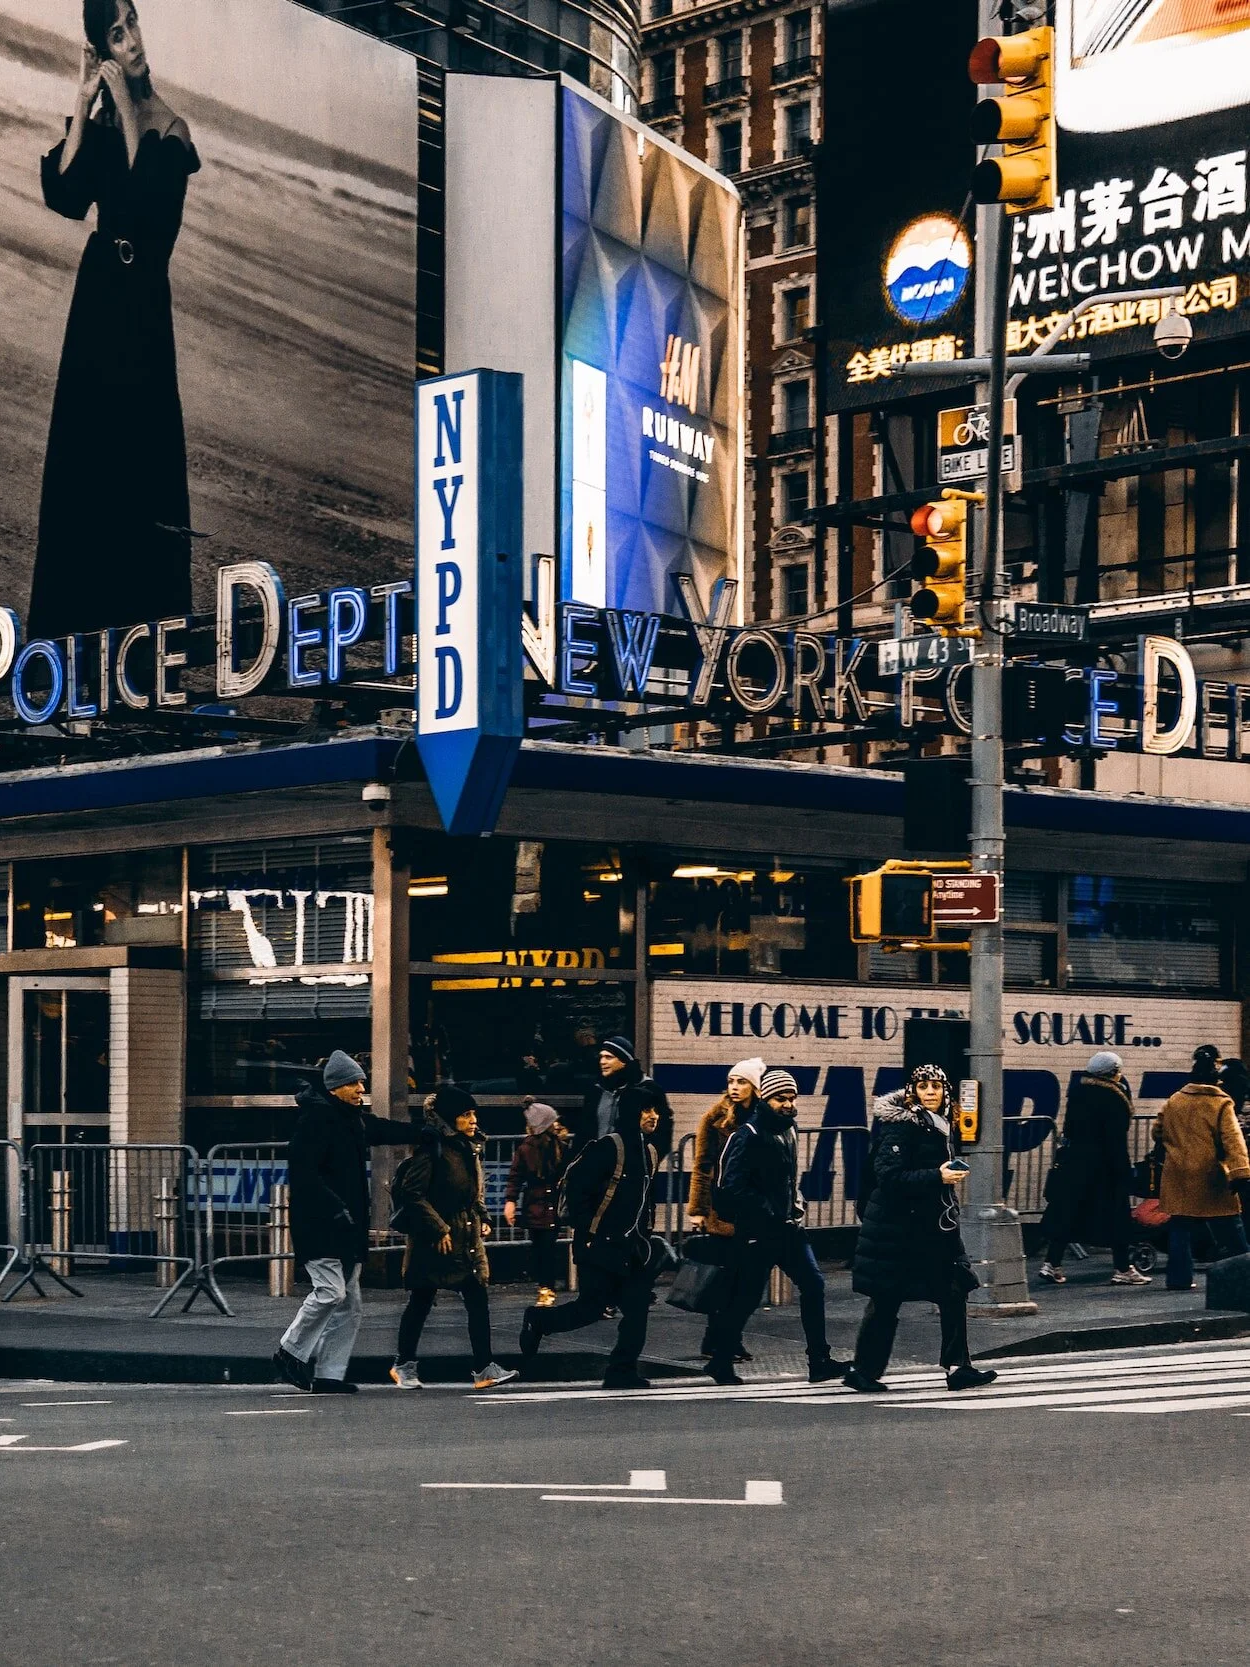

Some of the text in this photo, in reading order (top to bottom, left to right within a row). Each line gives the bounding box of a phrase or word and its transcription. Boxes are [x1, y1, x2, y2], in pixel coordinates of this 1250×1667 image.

[1009, 232, 1204, 308] WEICHOW
[660, 333, 701, 415] H&M
[642, 406, 715, 464] RUNWAY
[943, 446, 1013, 474] BIKE LE
[432, 389, 465, 721] NYPD
[215, 561, 412, 699] DEPT
[521, 553, 662, 698] NEW
[674, 572, 872, 722] YORK
[901, 641, 920, 668] W
[927, 637, 949, 664] 43
[1019, 607, 1086, 641] Broadway
[672, 1000, 850, 1040] WELCOME
[855, 1005, 899, 1041] TO
